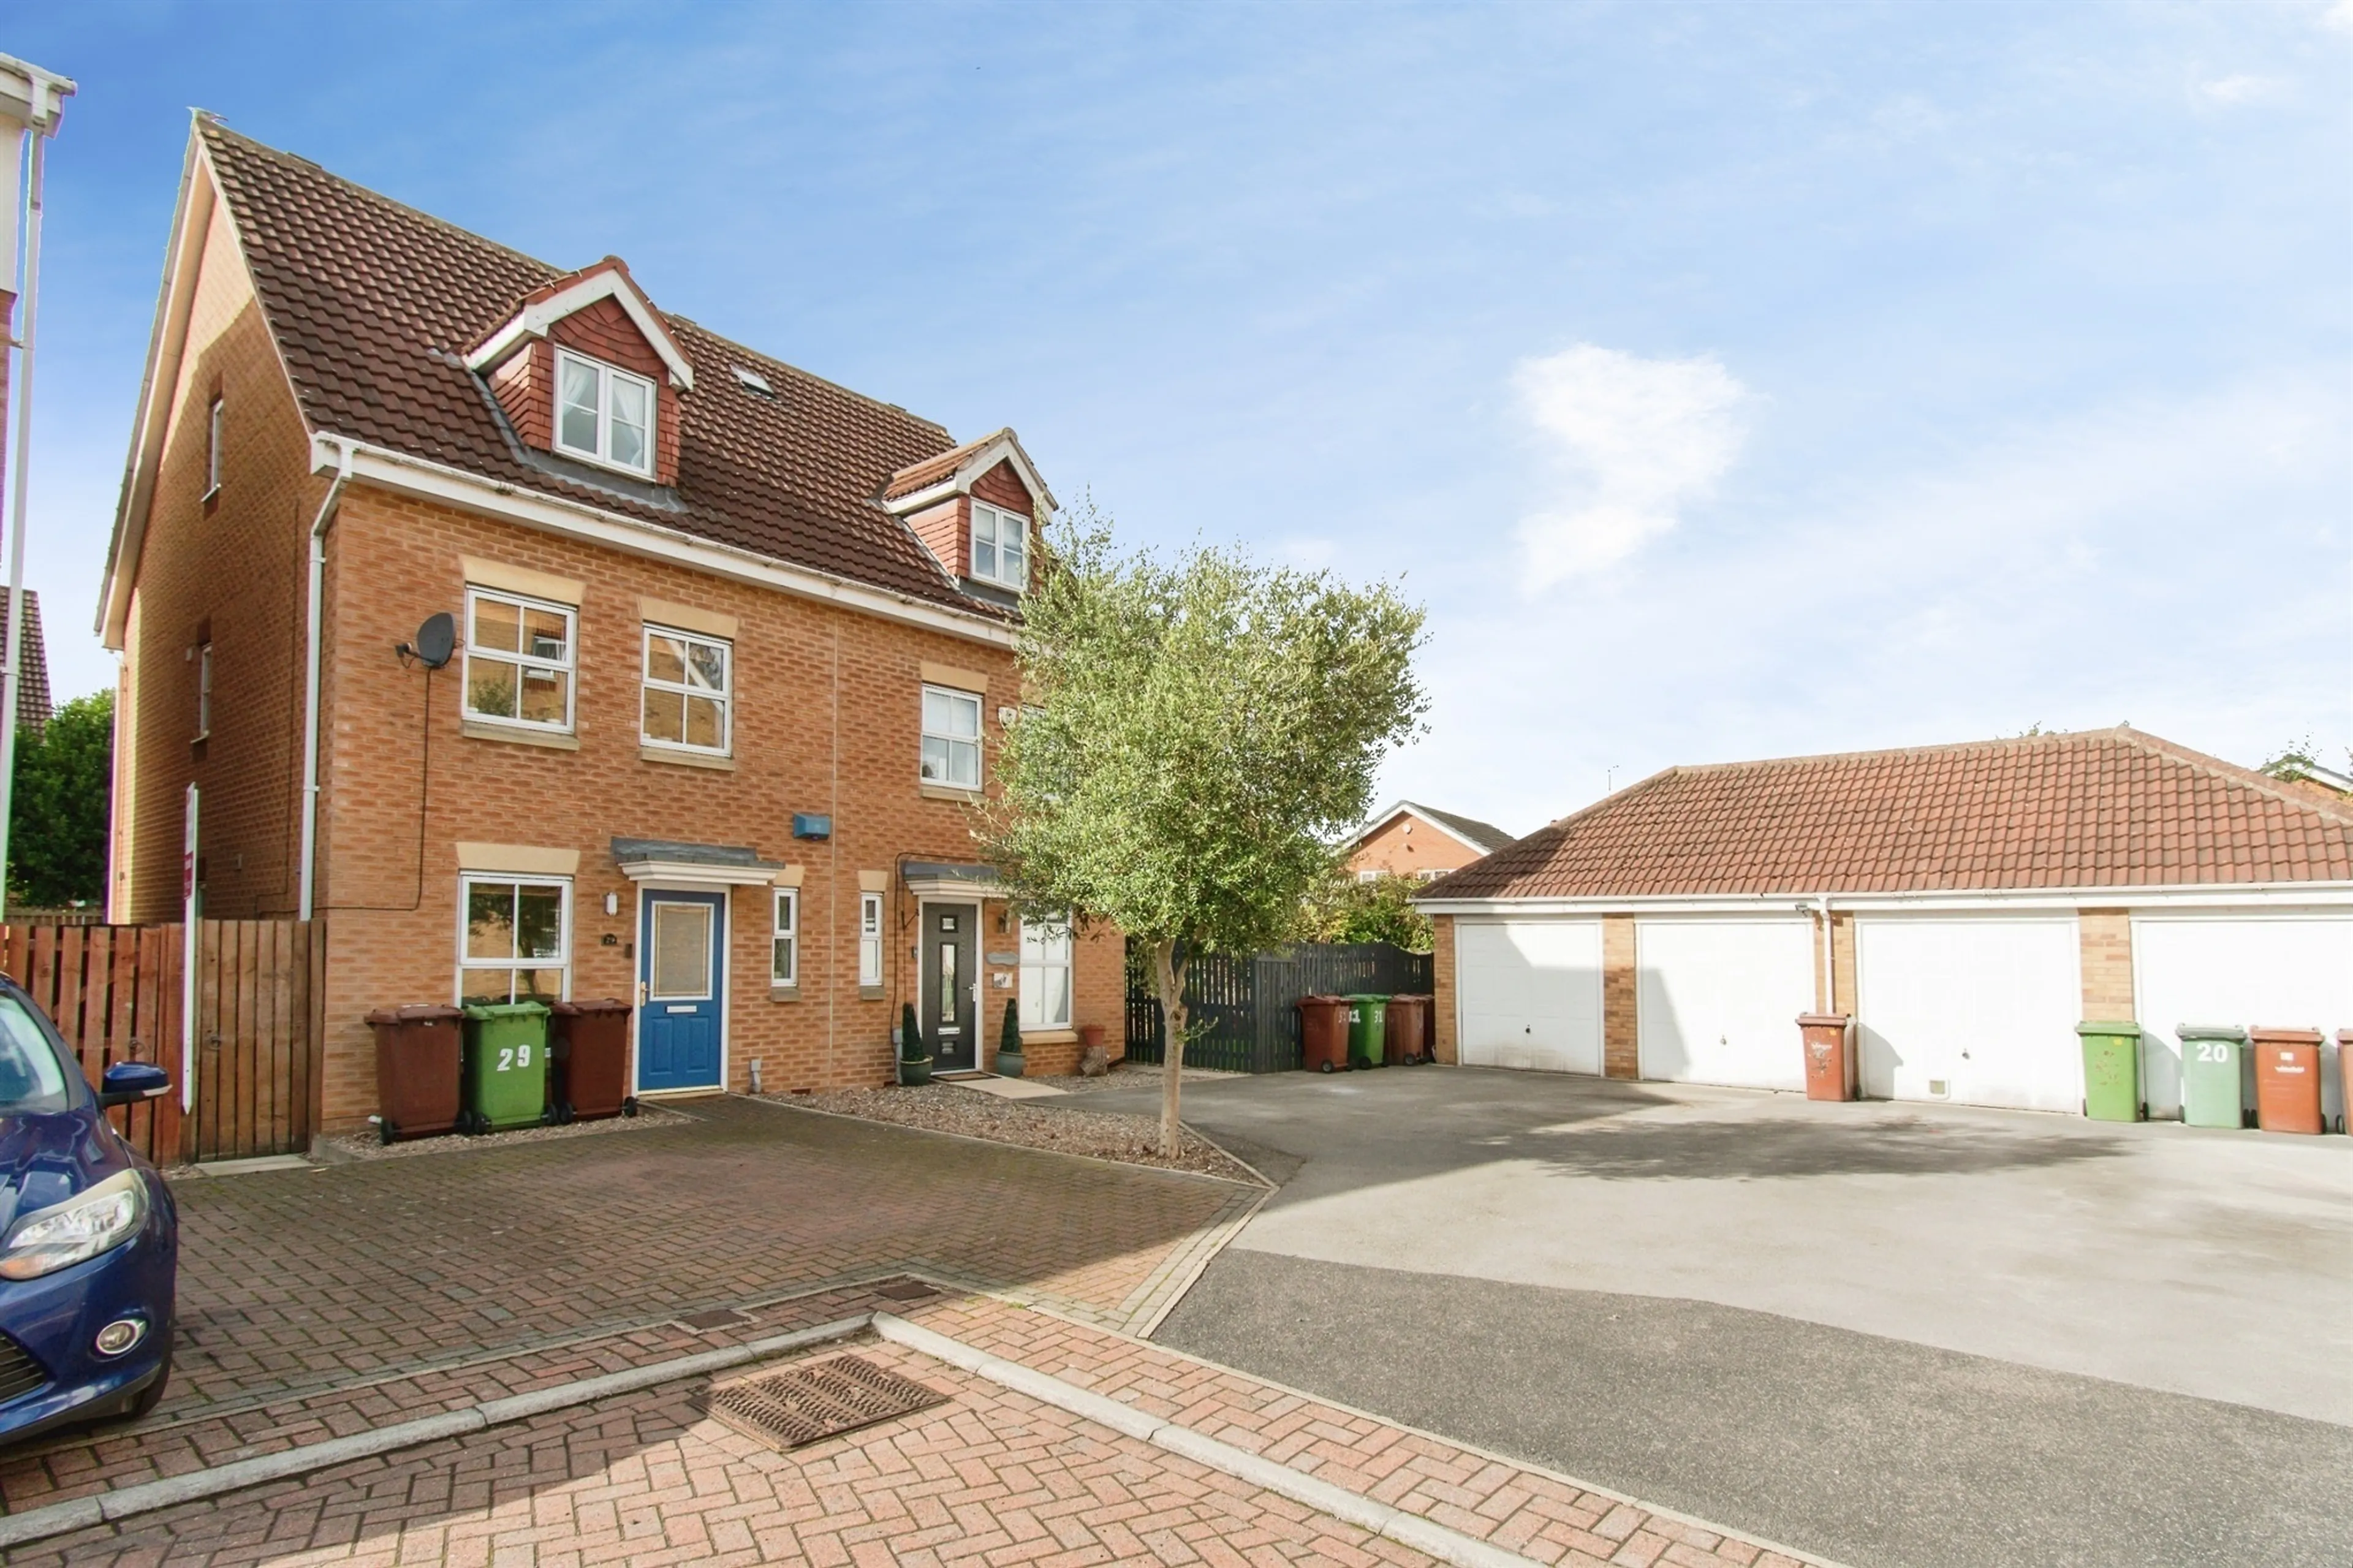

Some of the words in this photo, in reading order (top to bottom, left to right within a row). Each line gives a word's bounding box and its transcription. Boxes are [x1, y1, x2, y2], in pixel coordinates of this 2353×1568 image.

[1374, 1010, 1383, 1023] 31
[497, 1044, 531, 1071] 29
[2196, 1043, 2229, 1062] 20
